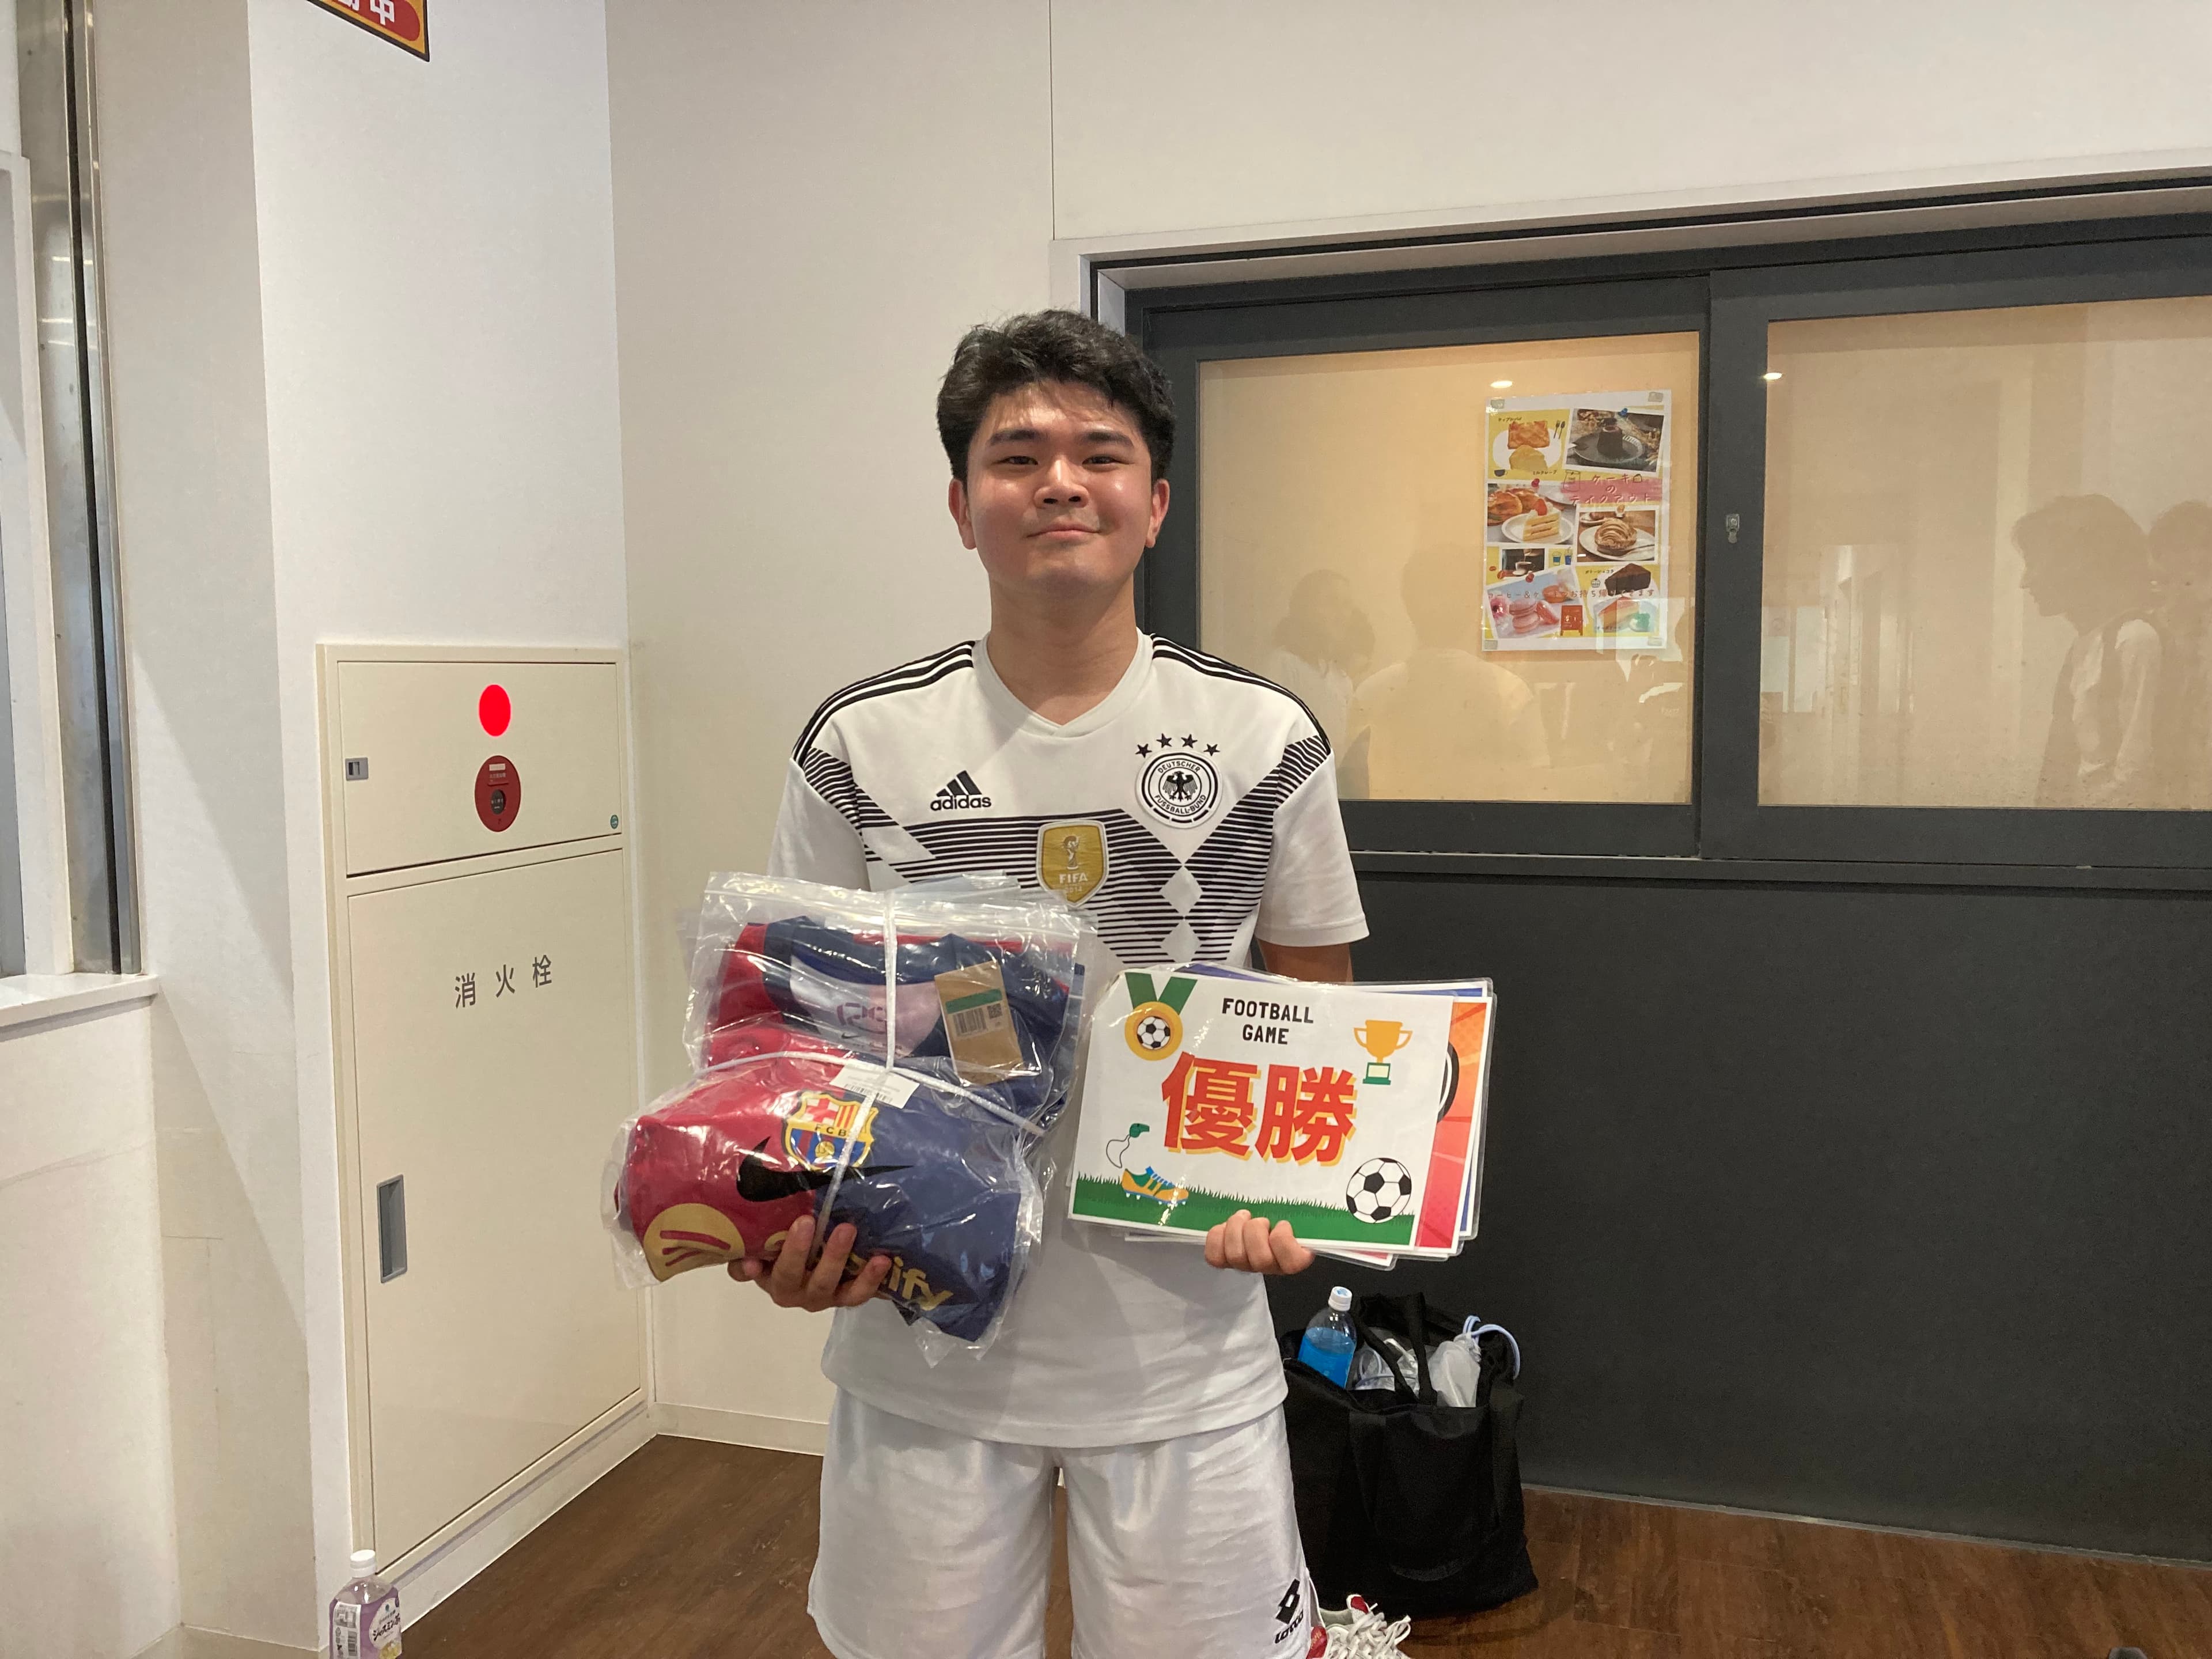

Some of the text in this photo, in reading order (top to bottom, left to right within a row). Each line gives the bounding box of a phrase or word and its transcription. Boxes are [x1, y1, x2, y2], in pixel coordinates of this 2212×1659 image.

[1592, 474, 1631, 484] ケーキ
[1606, 486, 1617, 494] の
[1570, 494, 1651, 504] テイクアウト
[1157, 760, 1200, 774] DEUTSCHER
[930, 794, 991, 811] adidas
[1154, 794, 1206, 814] FUSSBALL-BUND
[1059, 873, 1088, 884] FIFA
[454, 955, 552, 1008] 消火栓
[1222, 998, 1314, 1024] FOOTBALL
[1243, 1024, 1289, 1045] GAME
[1161, 1051, 1358, 1166] 優勝
[815, 1124, 847, 1137] FCB
